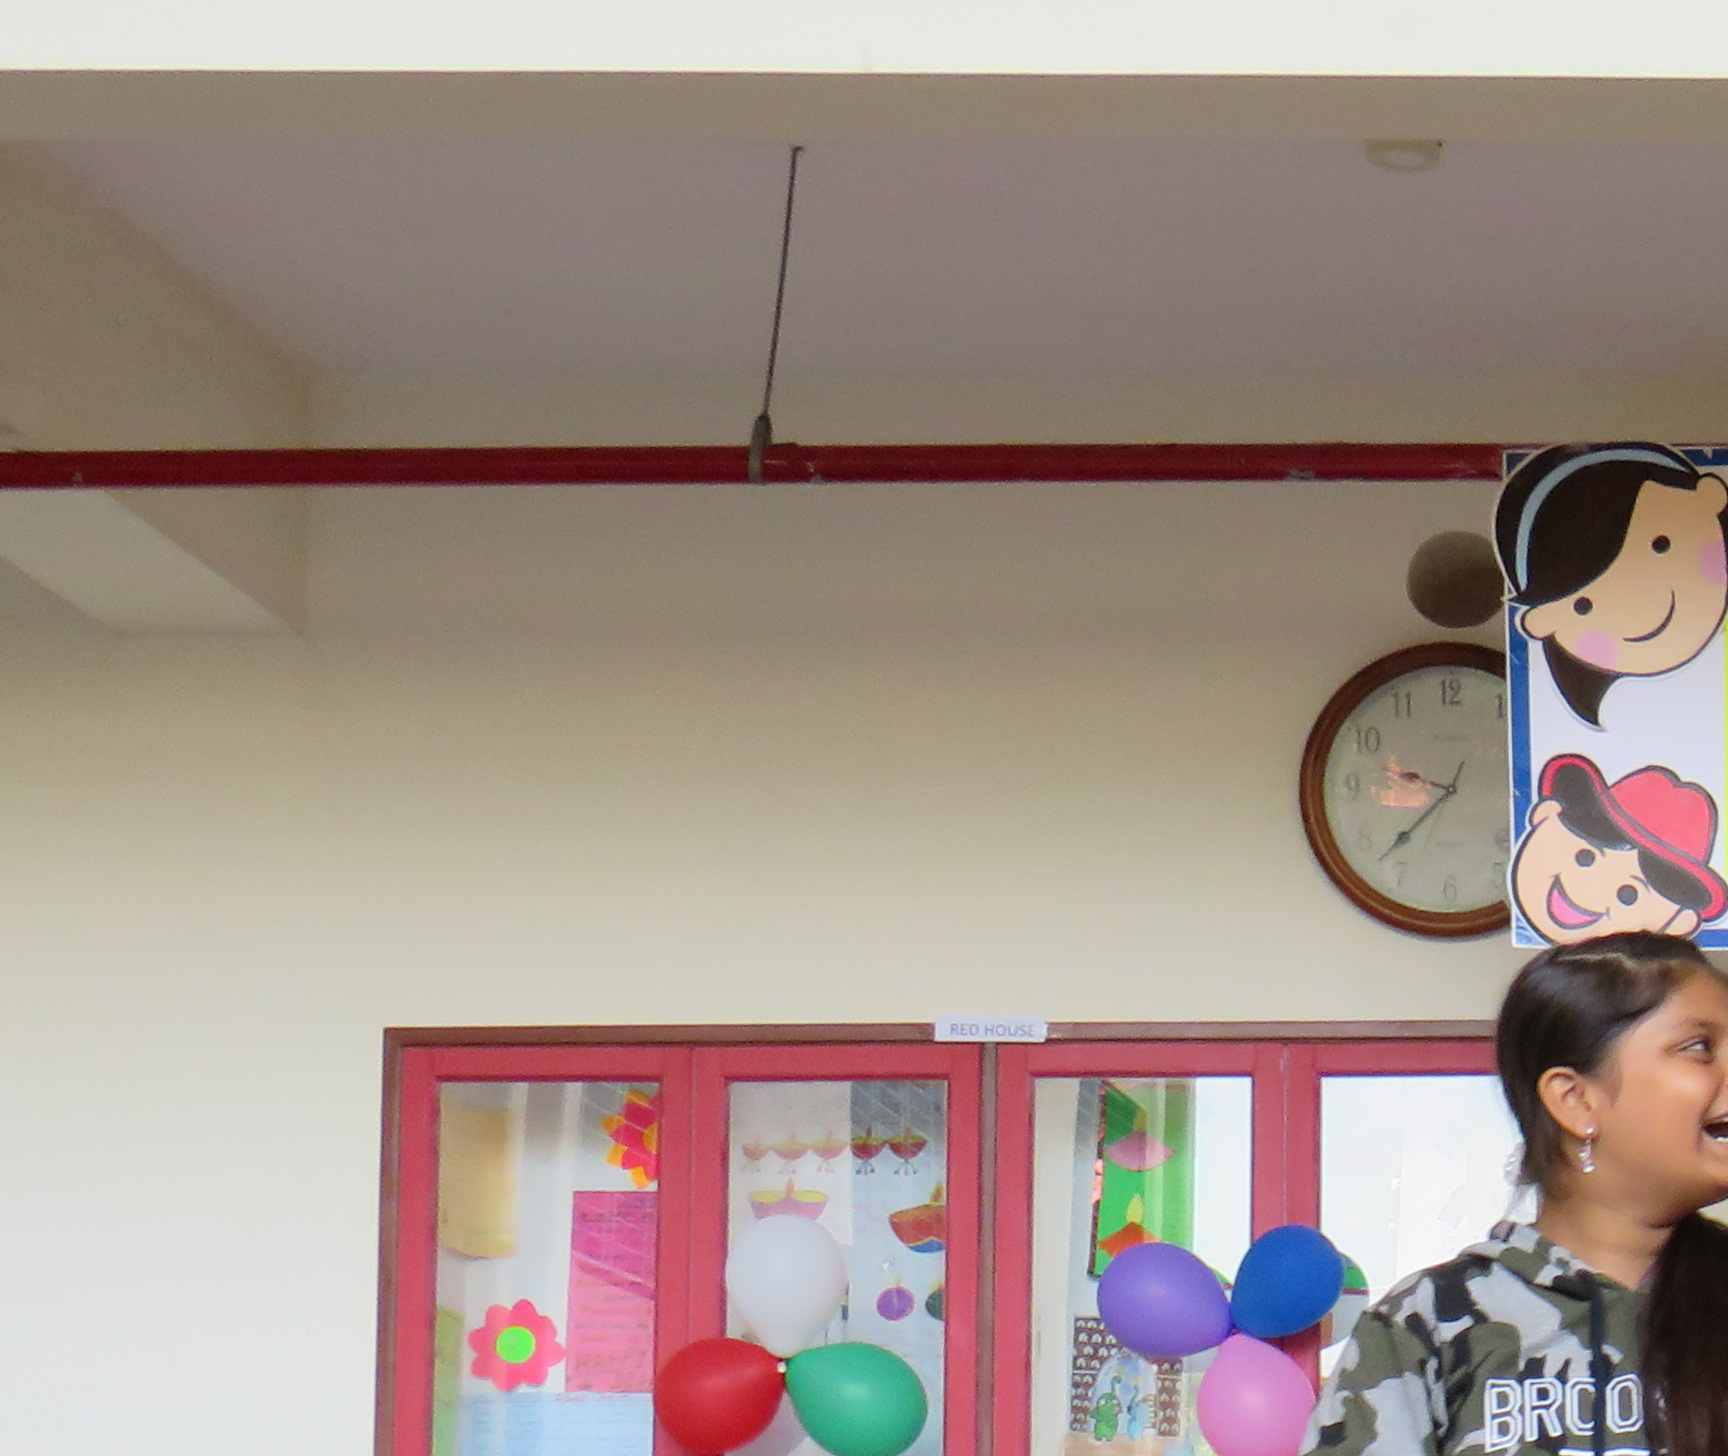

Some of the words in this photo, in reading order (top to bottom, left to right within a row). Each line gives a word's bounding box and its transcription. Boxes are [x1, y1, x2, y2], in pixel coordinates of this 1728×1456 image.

[1393, 690, 1413, 719] 11
[1440, 679, 1462, 706] 12
[1356, 725, 1381, 753] 10
[1483, 1373, 1644, 1454] BROO
